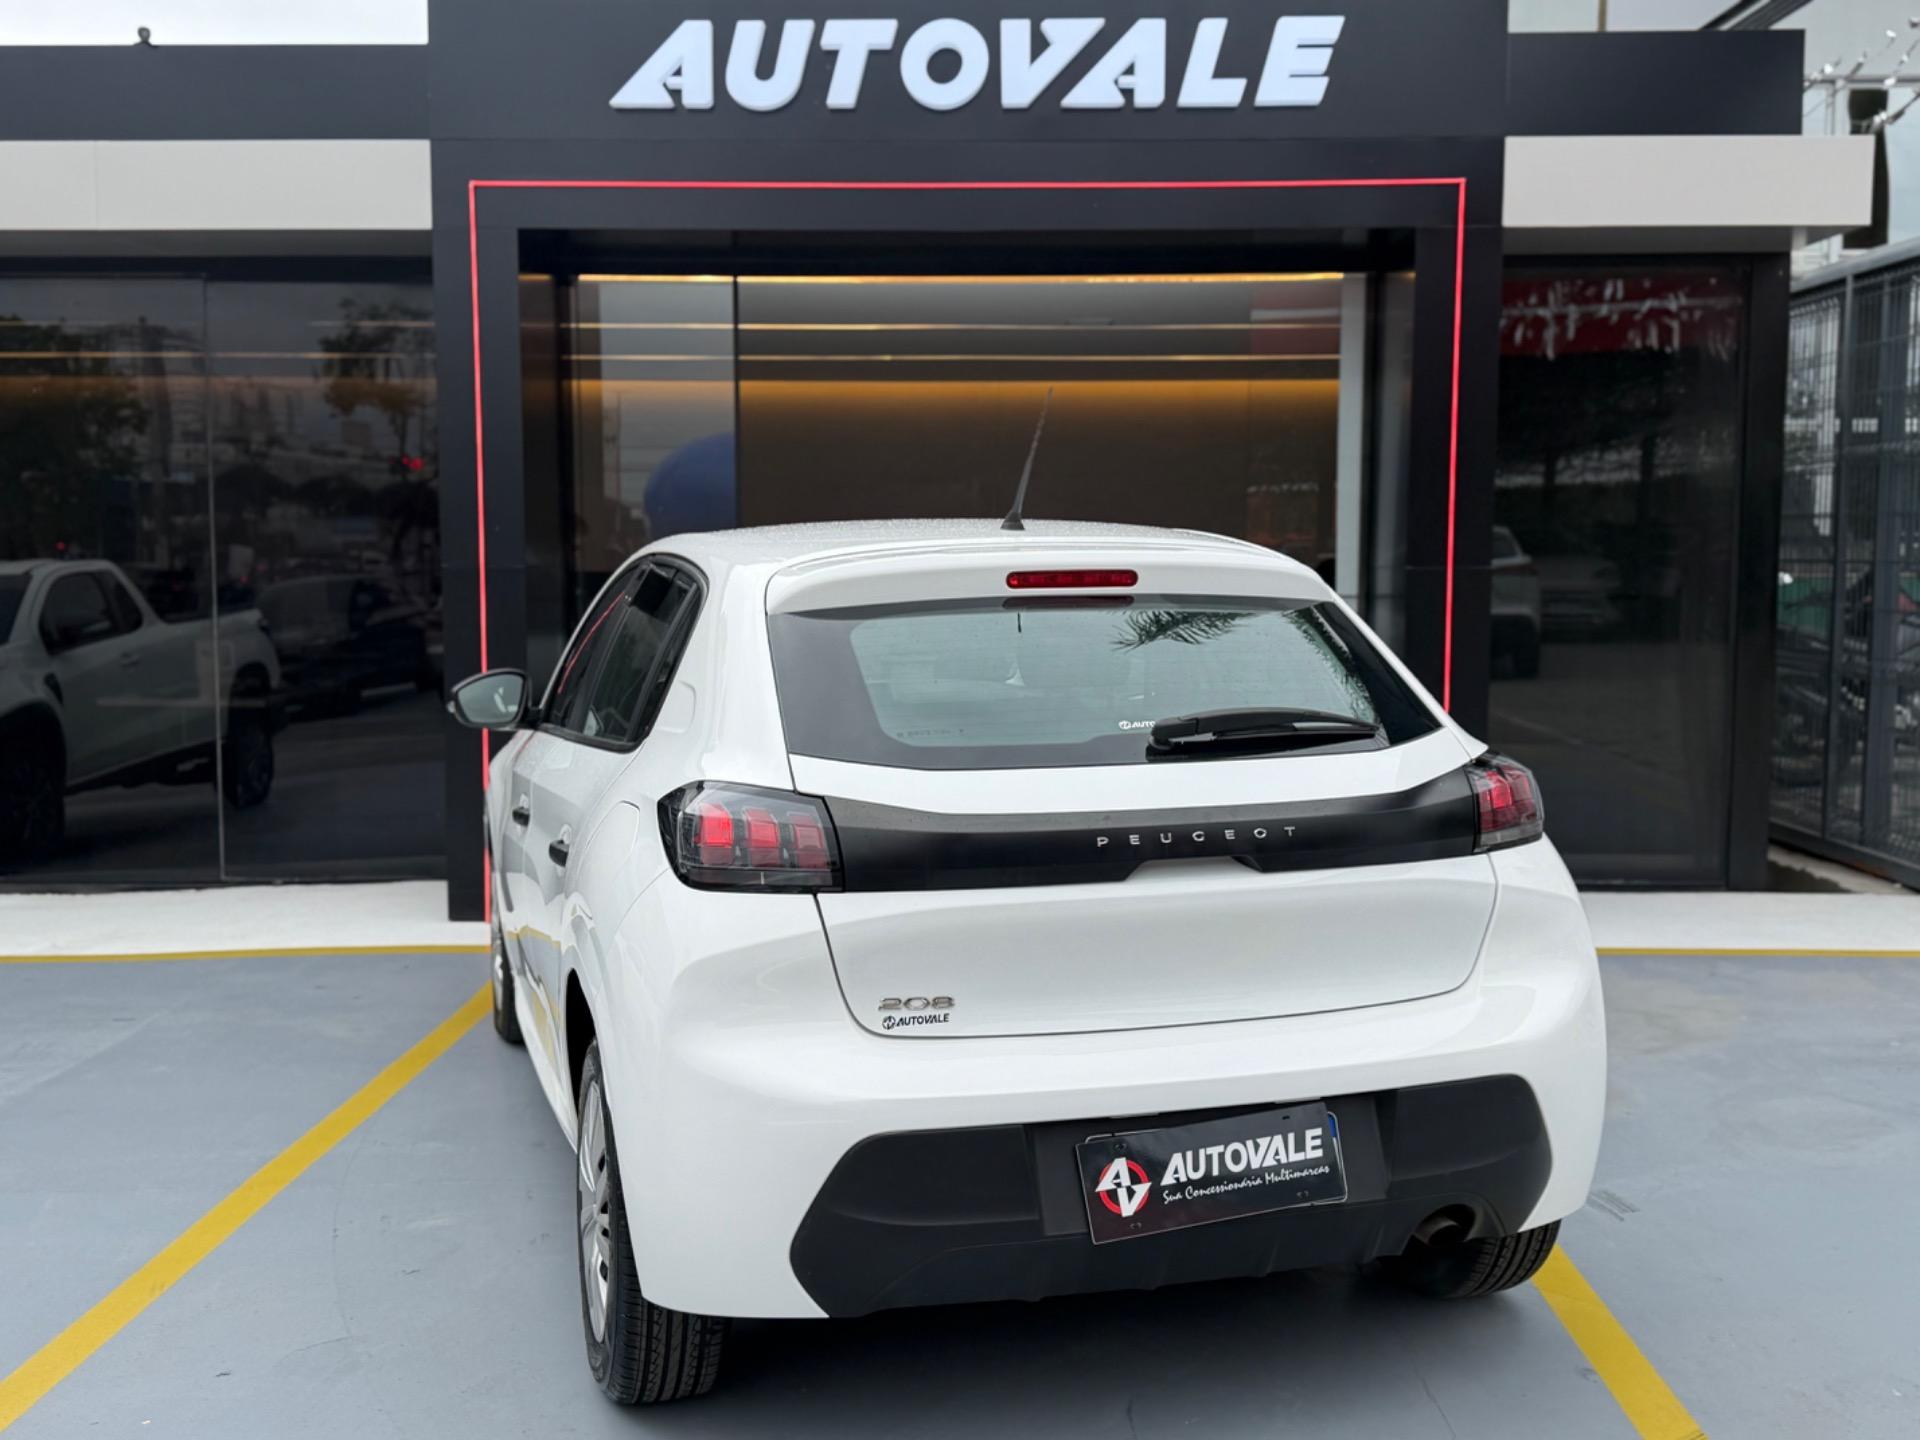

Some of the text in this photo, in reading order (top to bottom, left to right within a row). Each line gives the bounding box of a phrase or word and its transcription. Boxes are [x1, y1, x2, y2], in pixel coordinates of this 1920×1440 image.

[609, 15, 1345, 110] AUTOVALE
[1096, 826, 1295, 847] PEUGEOT
[878, 996, 955, 1011] 208
[896, 1013, 950, 1027] AUTOVALE
[1160, 1127, 1324, 1186] AUTOVALE
[1163, 1190, 1183, 1204] Sua
[1265, 1165, 1330, 1185] Multimarcas
